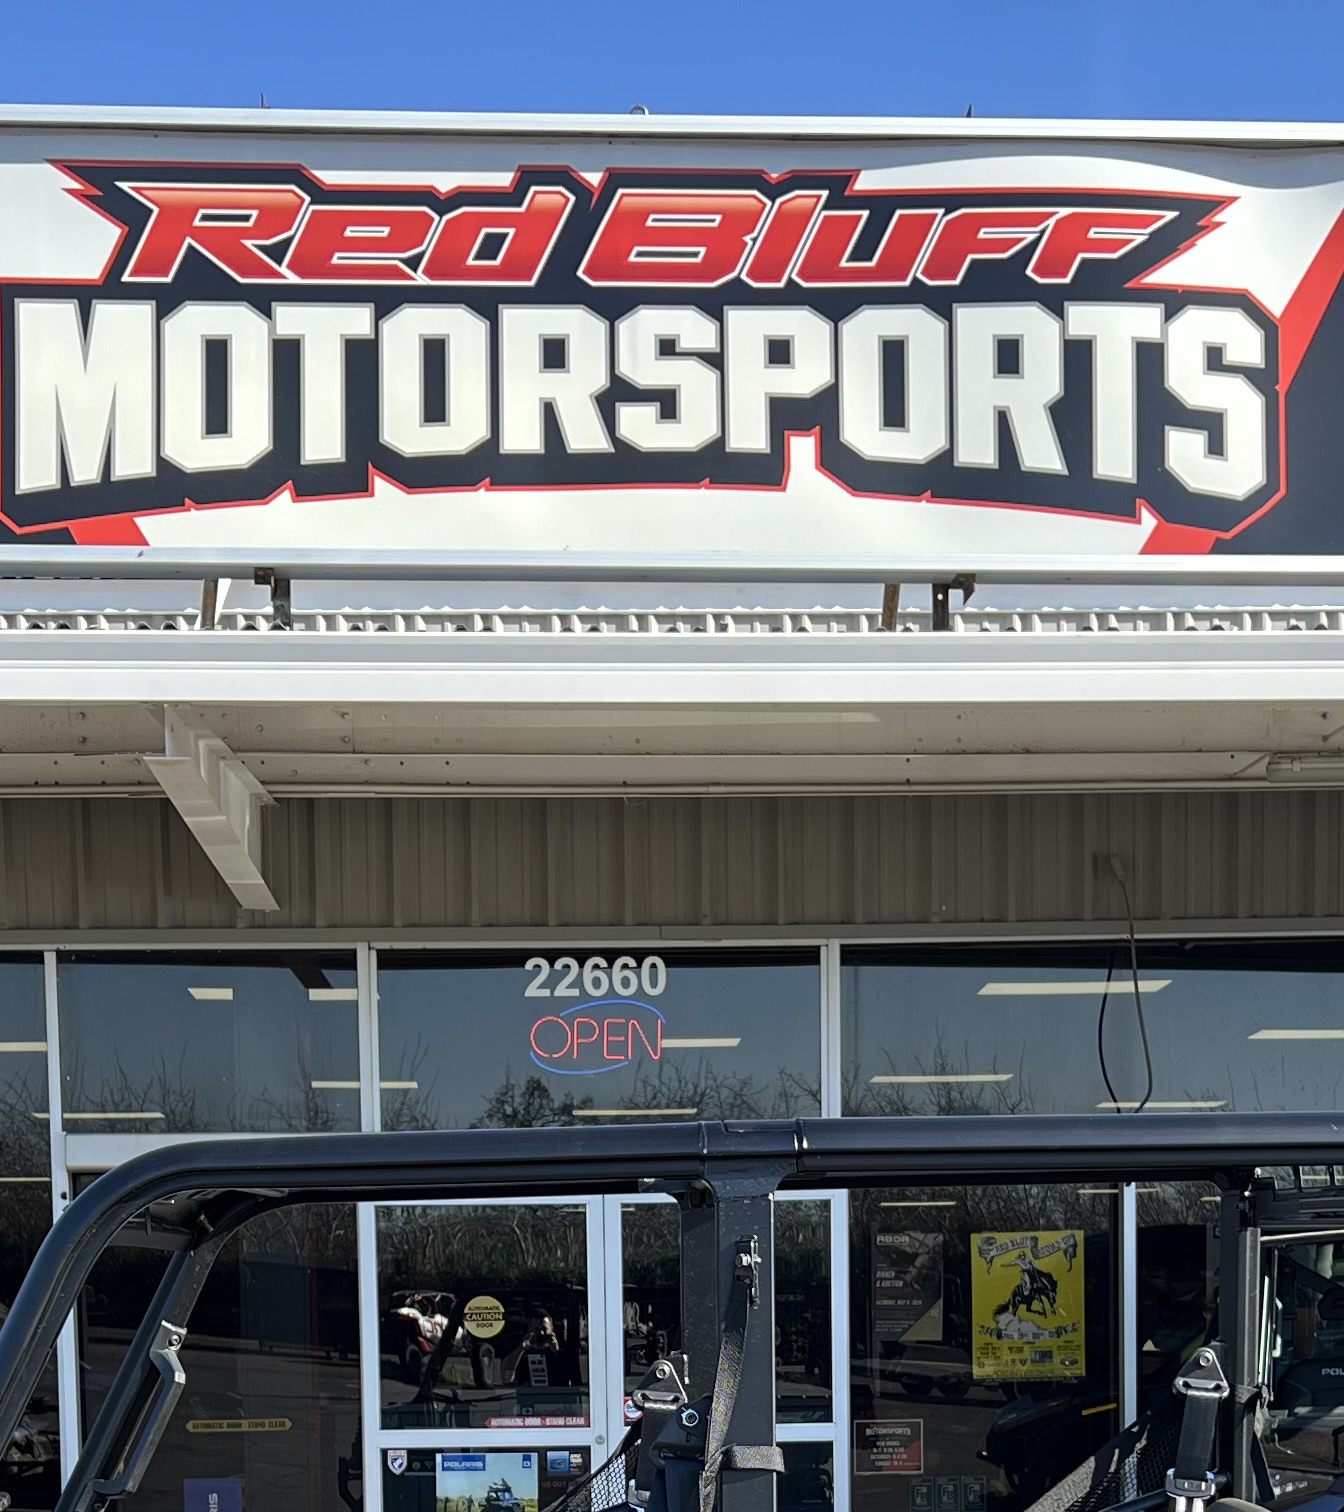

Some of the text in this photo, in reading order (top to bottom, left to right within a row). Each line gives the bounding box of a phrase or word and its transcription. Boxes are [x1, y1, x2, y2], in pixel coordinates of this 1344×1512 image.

[119, 180, 577, 285] Red
[13, 298, 1265, 502] MOTORSPORTS
[524, 955, 667, 998] 22660
[529, 1015, 663, 1060] OPEN
[466, 1312, 503, 1321] CAUTION
